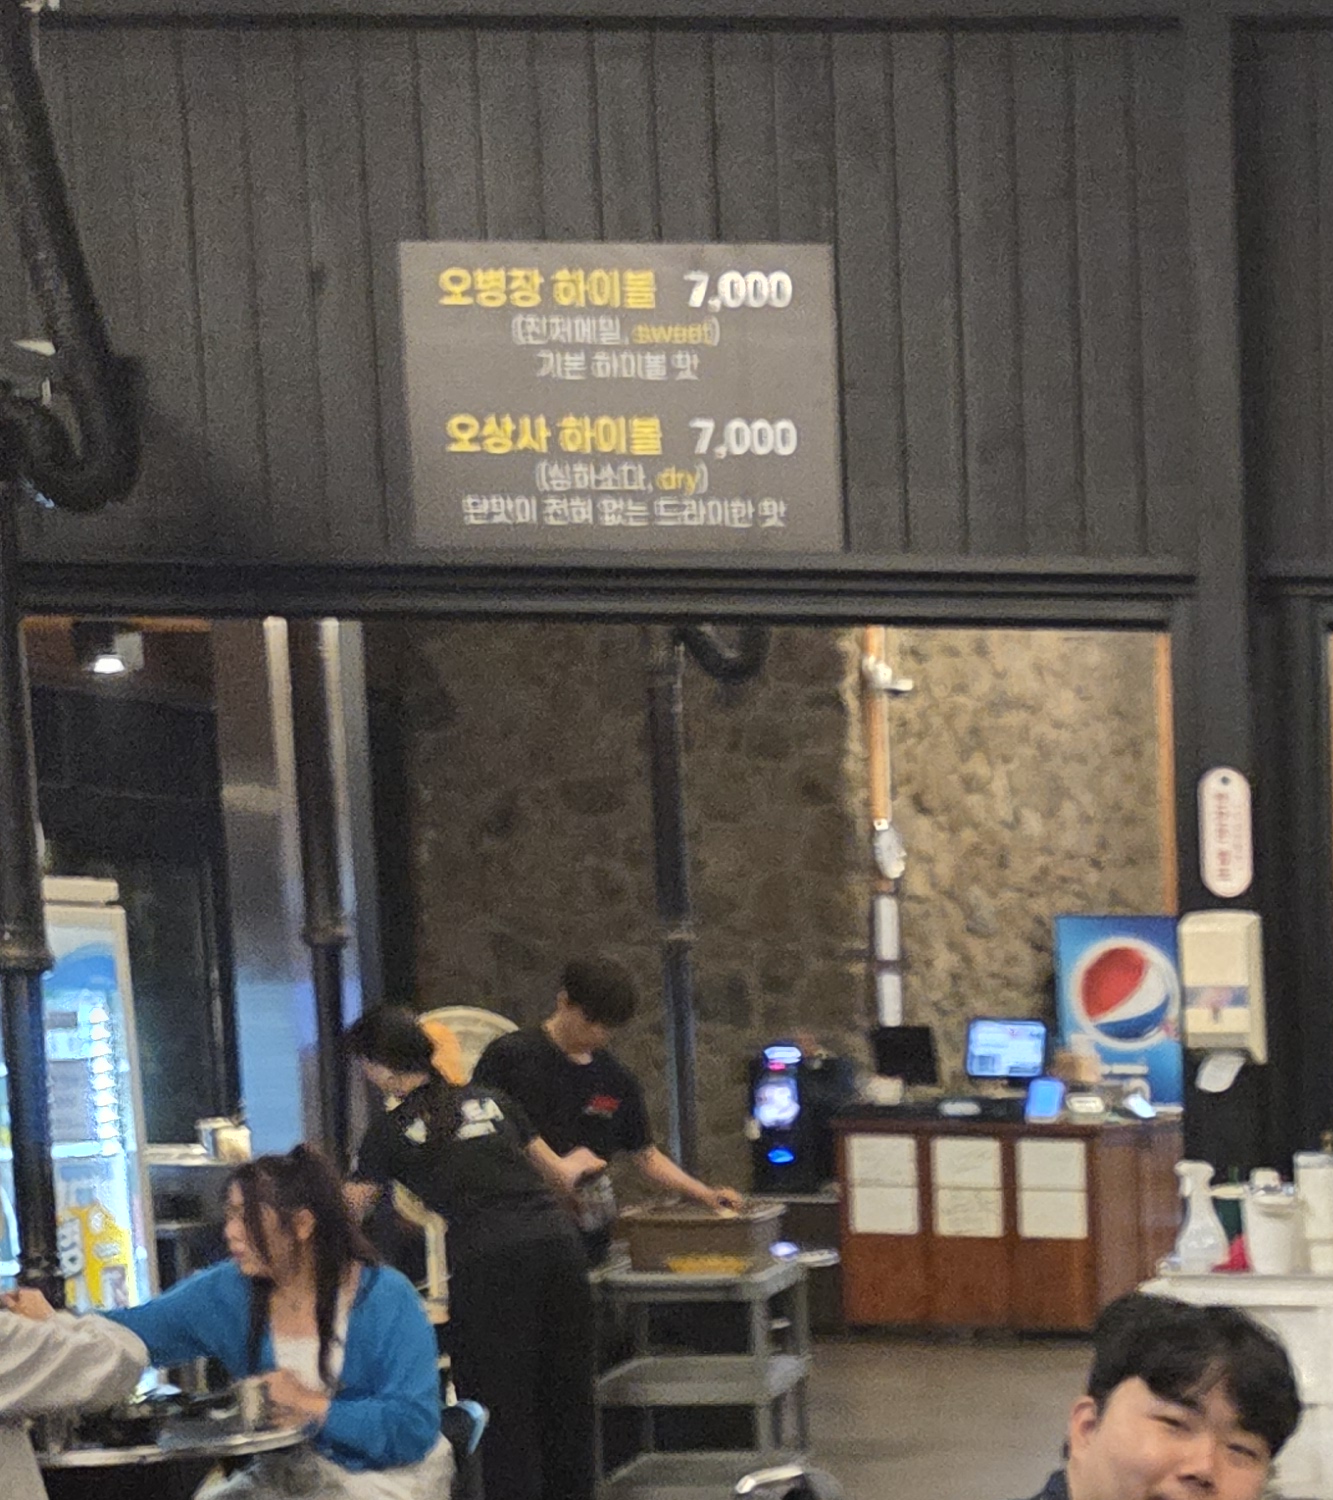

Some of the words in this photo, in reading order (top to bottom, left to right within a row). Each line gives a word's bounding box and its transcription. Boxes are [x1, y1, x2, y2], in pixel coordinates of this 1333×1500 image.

[438, 266, 544, 308] 오병장
[683, 269, 794, 313] 7,000
[445, 413, 552, 454] 오상사
[688, 416, 798, 460] 7,000
